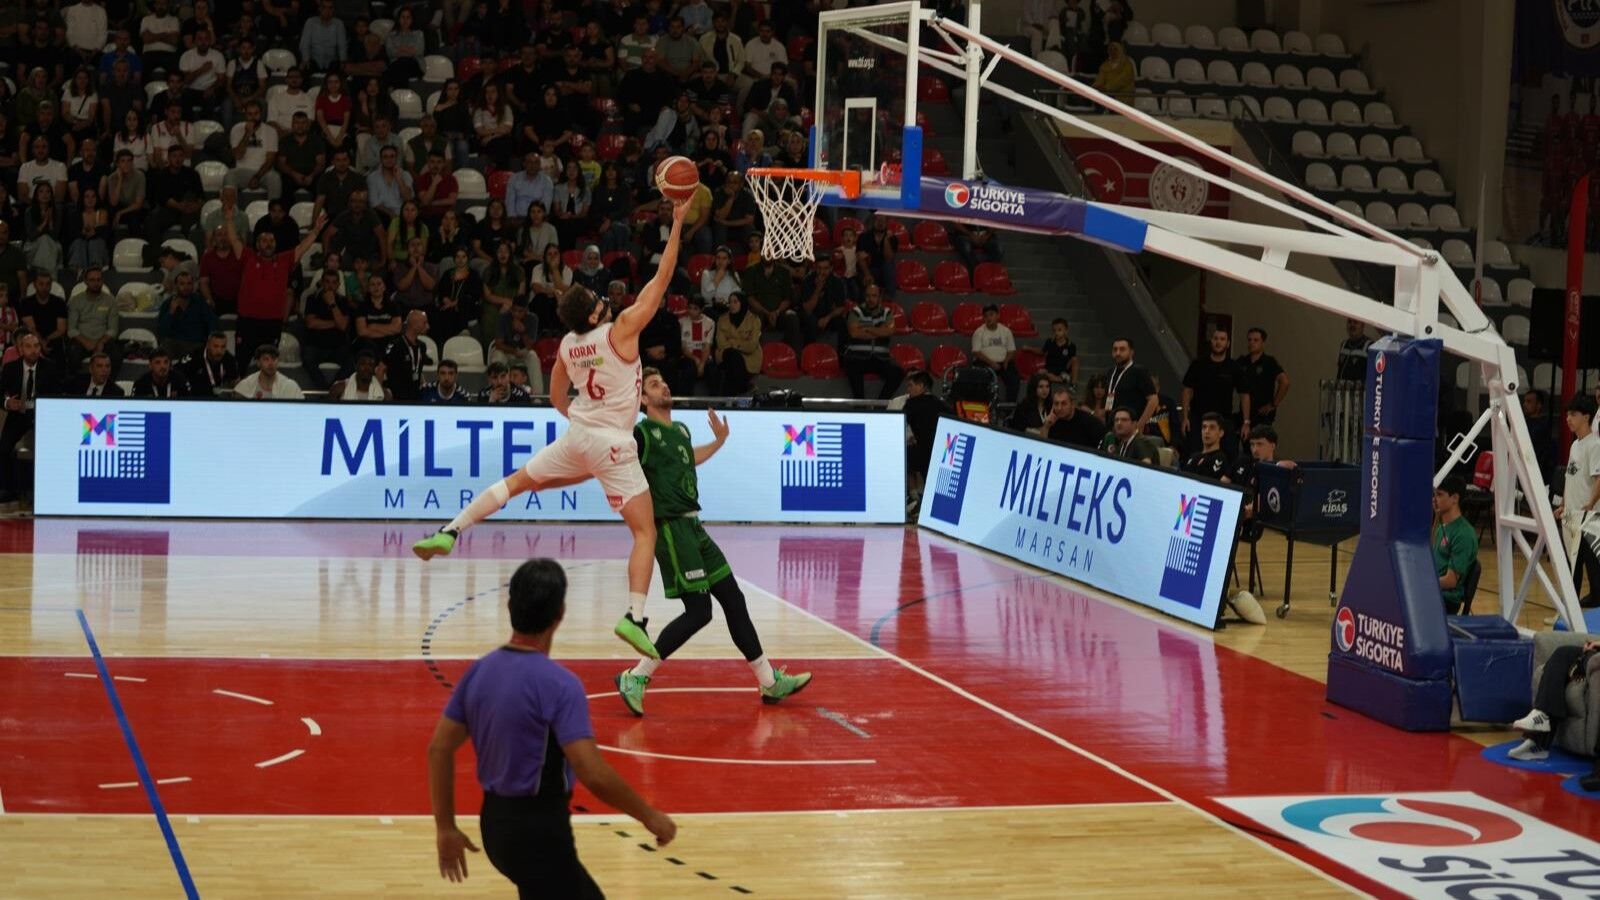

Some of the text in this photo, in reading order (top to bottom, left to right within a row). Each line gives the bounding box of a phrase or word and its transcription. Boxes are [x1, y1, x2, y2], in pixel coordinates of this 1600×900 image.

[568, 344, 597, 359] KORAY
[587, 368, 605, 400] 6
[321, 418, 556, 478] MİLTE
[385, 488, 577, 510] MARAN
[1015, 526, 1095, 573] MARSAN
[1357, 613, 1405, 648] TÜRKİYE
[1355, 636, 1404, 673] SİGORTA
